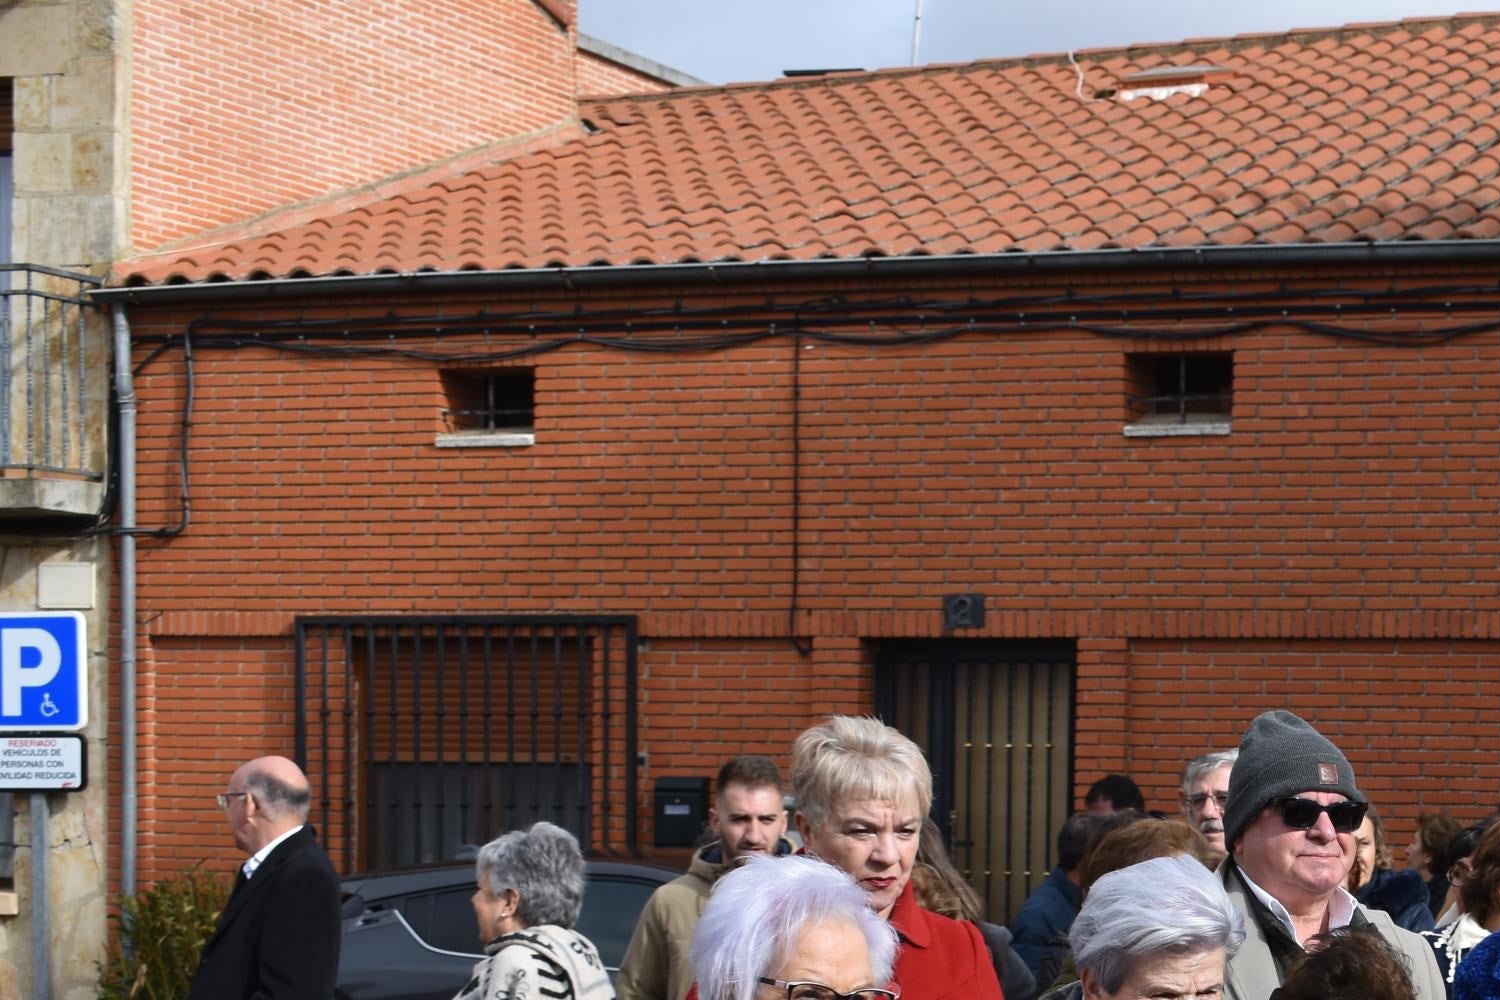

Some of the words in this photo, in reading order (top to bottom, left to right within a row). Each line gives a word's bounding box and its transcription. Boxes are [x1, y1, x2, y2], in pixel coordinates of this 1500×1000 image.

[2, 628, 61, 716] P
[8, 739, 57, 747] RESERVADO
[0, 760, 44, 768] PERSONAS
[46, 760, 64, 768] CON
[35, 772, 76, 780] REDUCIDA
